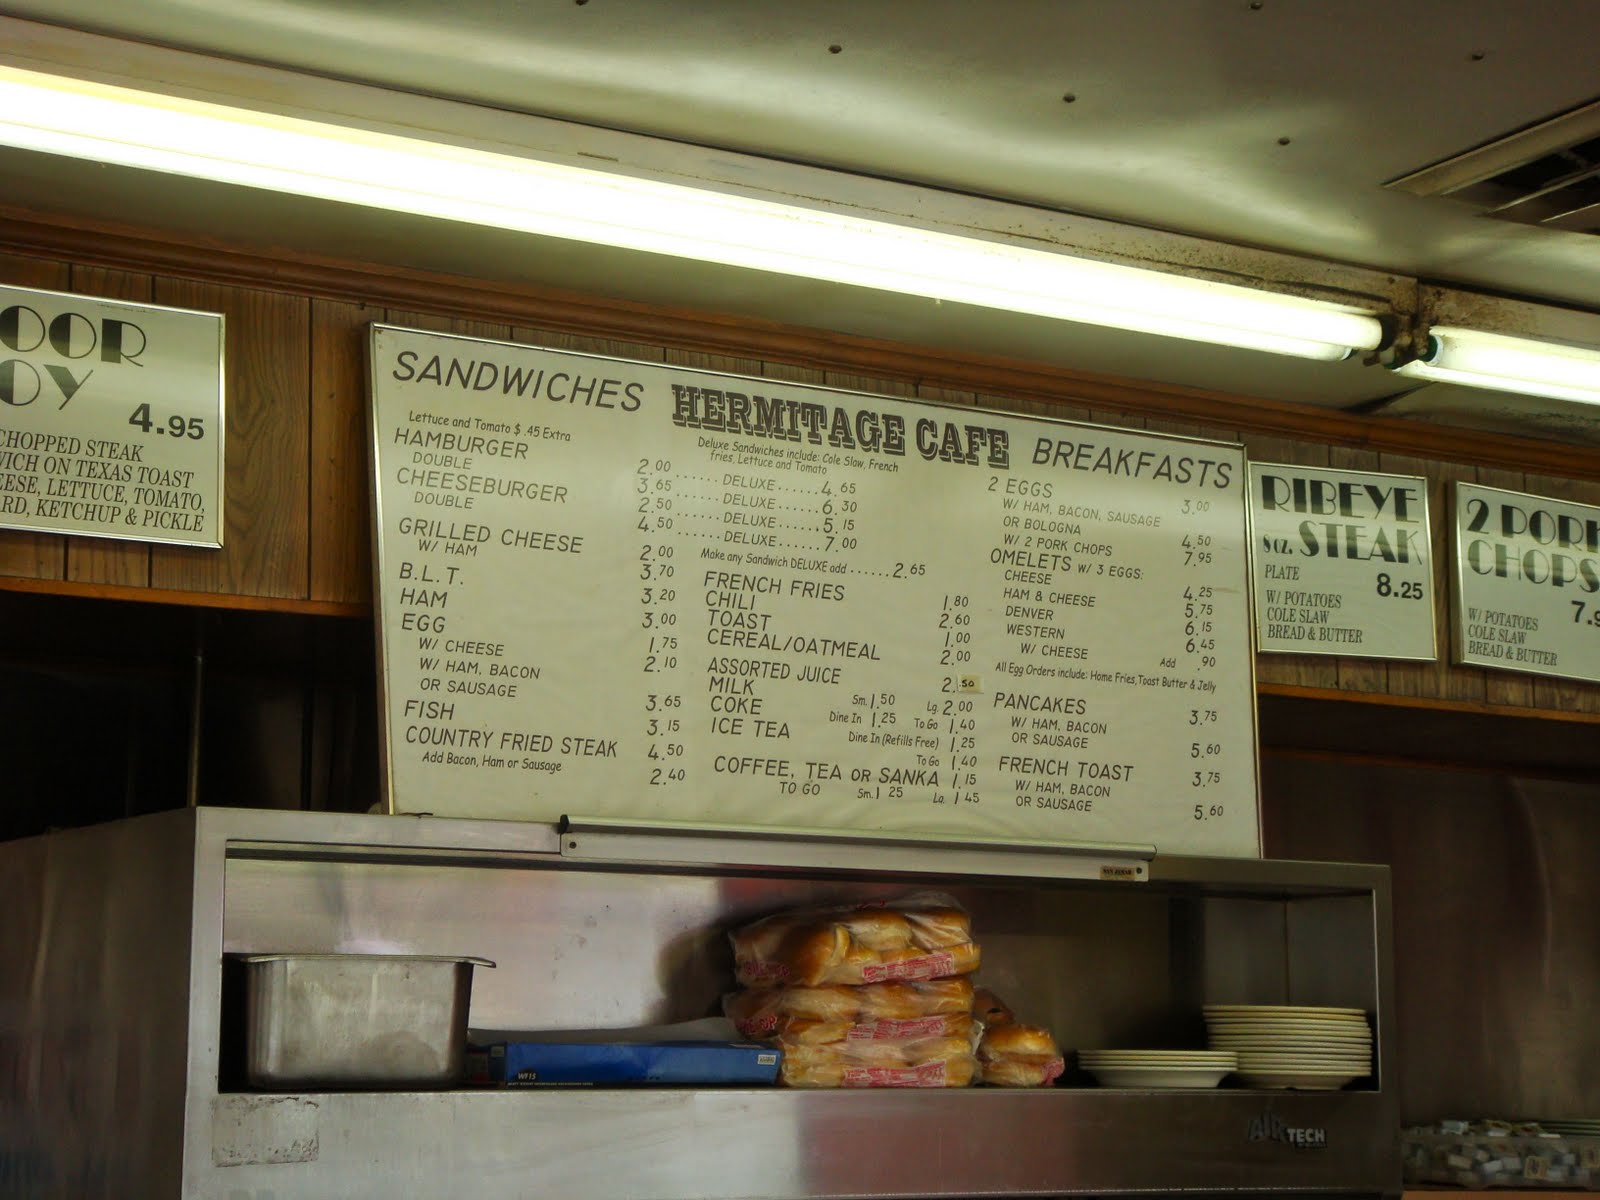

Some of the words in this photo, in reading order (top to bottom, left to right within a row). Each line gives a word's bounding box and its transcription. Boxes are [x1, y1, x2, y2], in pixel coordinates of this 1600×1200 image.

[393, 351, 644, 412] SANDWICHES
[129, 403, 204, 440] 4.95
[409, 410, 449, 426] Lettuce
[474, 419, 511, 434] Tomato
[542, 427, 571, 441] Extra
[671, 383, 906, 456] HERMITAGE
[916, 417, 1010, 470] CAFE
[86, 440, 144, 462] STEAK
[394, 427, 528, 459] HAMBURGER
[412, 452, 473, 470] DOUBLE
[698, 437, 730, 450] Deluxe
[732, 441, 784, 457] Sandwiches
[822, 453, 841, 465] Cole
[869, 459, 899, 472] French
[637, 459, 671, 475] 2.00
[738, 454, 774, 470] Lettuce
[795, 461, 827, 474] Tomato
[1032, 438, 1232, 489] BREAKFASTS
[44, 457, 70, 477] ON
[76, 461, 132, 484] TEXAS
[138, 467, 194, 489] TOAST
[396, 468, 568, 503] CHEESEBURGER
[637, 478, 672, 495] 3.65
[723, 475, 776, 491] DELUXE
[821, 481, 856, 497] 4.65
[988, 477, 998, 491] 2
[1006, 479, 1053, 499] EGGS
[638, 498, 672, 513] 2.50
[723, 494, 776, 510] DELUXE
[822, 500, 857, 515] 6.30
[1262, 475, 1419, 523] RIBEYE
[36, 498, 121, 524] KETCHUP
[143, 511, 203, 532] PICKLE
[1107, 511, 1161, 527] SAUSAGE
[1467, 499, 1490, 534] 2
[637, 516, 673, 533] 4.50
[823, 518, 855, 534] 5.15
[1024, 518, 1081, 535] BOLOGNA
[399, 517, 491, 543] GRILLED
[501, 529, 583, 553] CHEESE
[1181, 535, 1211, 549] 4.50
[1300, 520, 1422, 565] STEAK
[445, 542, 477, 556] HAM
[825, 536, 857, 552] 7.00
[1037, 538, 1068, 551] PORK
[1074, 543, 1112, 556] CHOPS
[640, 546, 674, 562] 2.00
[701, 548, 725, 561] Make
[746, 553, 788, 568] Sandwich
[990, 548, 1071, 571] OMELETS
[1184, 552, 1212, 566] 7.95
[640, 563, 674, 580] 3.70
[892, 563, 925, 579] 2.65
[1265, 565, 1299, 581] PLATE
[1468, 539, 1600, 593] CHOPS
[704, 571, 781, 594] FRENCH
[791, 581, 845, 601] FRIES
[1005, 570, 1052, 585] CHEESE
[1004, 589, 1030, 601] HAM
[1183, 586, 1212, 601] 4.25
[1377, 573, 1423, 600] 8.25
[400, 588, 447, 608] HAM
[641, 588, 675, 605] 3.20
[705, 591, 755, 610] CHILI
[943, 596, 969, 611] 1.80
[1285, 591, 1341, 608] POTATOES
[1006, 606, 1054, 620] DENVER
[1185, 603, 1212, 619] 5.75
[1267, 607, 1296, 622] COLE
[1300, 609, 1329, 624] SLAW
[402, 613, 446, 633] EGG
[642, 612, 676, 629] 3.00
[708, 610, 772, 631] TOAST
[938, 613, 970, 629] 2.60
[1185, 621, 1212, 636] 6.15
[1485, 611, 1538, 631] POTATOES
[945, 631, 970, 647] 1.00
[1007, 624, 1065, 639] WESTERN
[1268, 624, 1305, 640] BREAD
[1319, 629, 1362, 643] BUTTER
[1468, 625, 1495, 641] COLE
[1499, 629, 1526, 644] SLAW
[445, 640, 504, 656] CHEESE
[649, 637, 677, 653] 1.75
[708, 629, 880, 660] CEREAL/OATMEAL
[1186, 639, 1215, 653] 6.45
[940, 650, 971, 666] 2.00
[1468, 641, 1503, 658] BREAD
[1516, 648, 1557, 666] BUTTER
[490, 663, 540, 679] BACON
[644, 656, 677, 673] 2.10
[708, 657, 790, 679] ASSORTED
[797, 665, 841, 684] JUICE
[1160, 658, 1176, 668] Add
[709, 676, 754, 696] MILK
[996, 661, 1007, 672] All
[1009, 663, 1024, 676] Egg
[1026, 665, 1055, 677] Orders
[1091, 671, 1112, 682] Home
[1139, 675, 1159, 687] Toast
[1162, 677, 1187, 688] Butter
[1197, 680, 1216, 694] Jelly
[447, 680, 517, 697] SAUSAGE
[404, 700, 454, 720] FISH
[645, 695, 681, 711] 3.65
[711, 696, 762, 715] COKE
[830, 711, 849, 723] Dine
[943, 700, 973, 716] 2.00
[994, 692, 1087, 715] PANCAKES
[1189, 710, 1217, 726] 3.75
[646, 719, 680, 736] 3.15
[712, 717, 743, 735] ICE
[754, 720, 790, 738] TEA
[406, 726, 493, 749] COUNTRY
[501, 733, 552, 752] FRIED
[561, 737, 618, 757] STEAK
[648, 744, 683, 761] 4.50
[1191, 743, 1221, 759] 5.60
[422, 752, 443, 763] Add
[482, 756, 504, 768] Ham
[522, 759, 562, 774] Sausage
[999, 756, 1068, 777] FRENCH
[1078, 762, 1134, 782] TOAST
[650, 769, 685, 785] 2.40
[806, 762, 841, 780] TEA
[879, 767, 939, 786] SANKA
[1192, 772, 1220, 787] 3.75
[780, 782, 796, 794] TO
[803, 783, 821, 795] GO
[1194, 805, 1223, 820] 5.60
